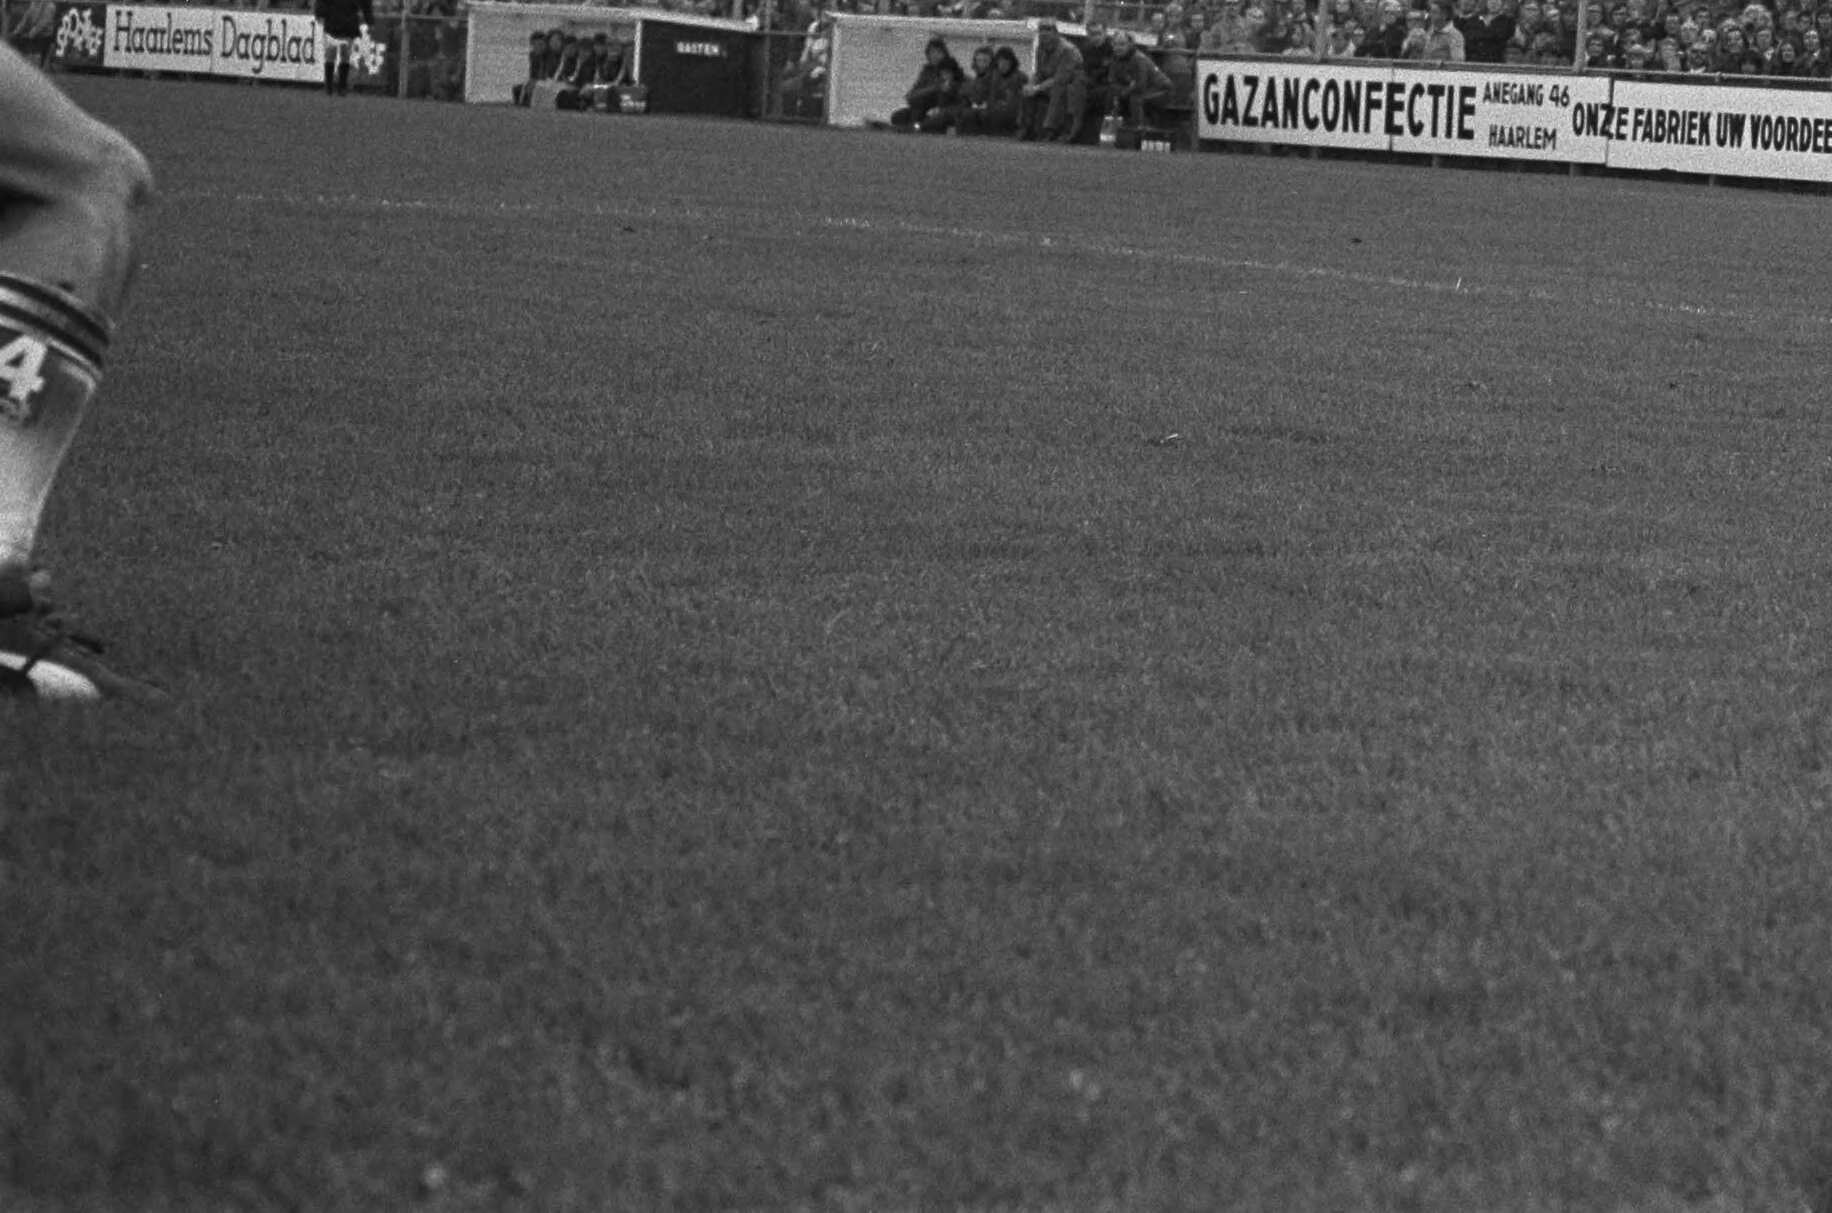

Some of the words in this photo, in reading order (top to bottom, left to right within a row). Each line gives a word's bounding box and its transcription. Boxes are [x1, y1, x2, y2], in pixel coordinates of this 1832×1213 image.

[113, 10, 214, 58] Haarlems
[220, 15, 316, 74] Dagblad
[1203, 73, 1477, 140] GAZANCONFECTIE
[1483, 81, 1544, 107] ANEGANG
[1549, 84, 1570, 108] 46
[1489, 123, 1557, 151] HAARLEM
[1572, 101, 1629, 141] ONZE
[1632, 106, 1712, 147] FABRIEK
[1716, 111, 1747, 149] UW
